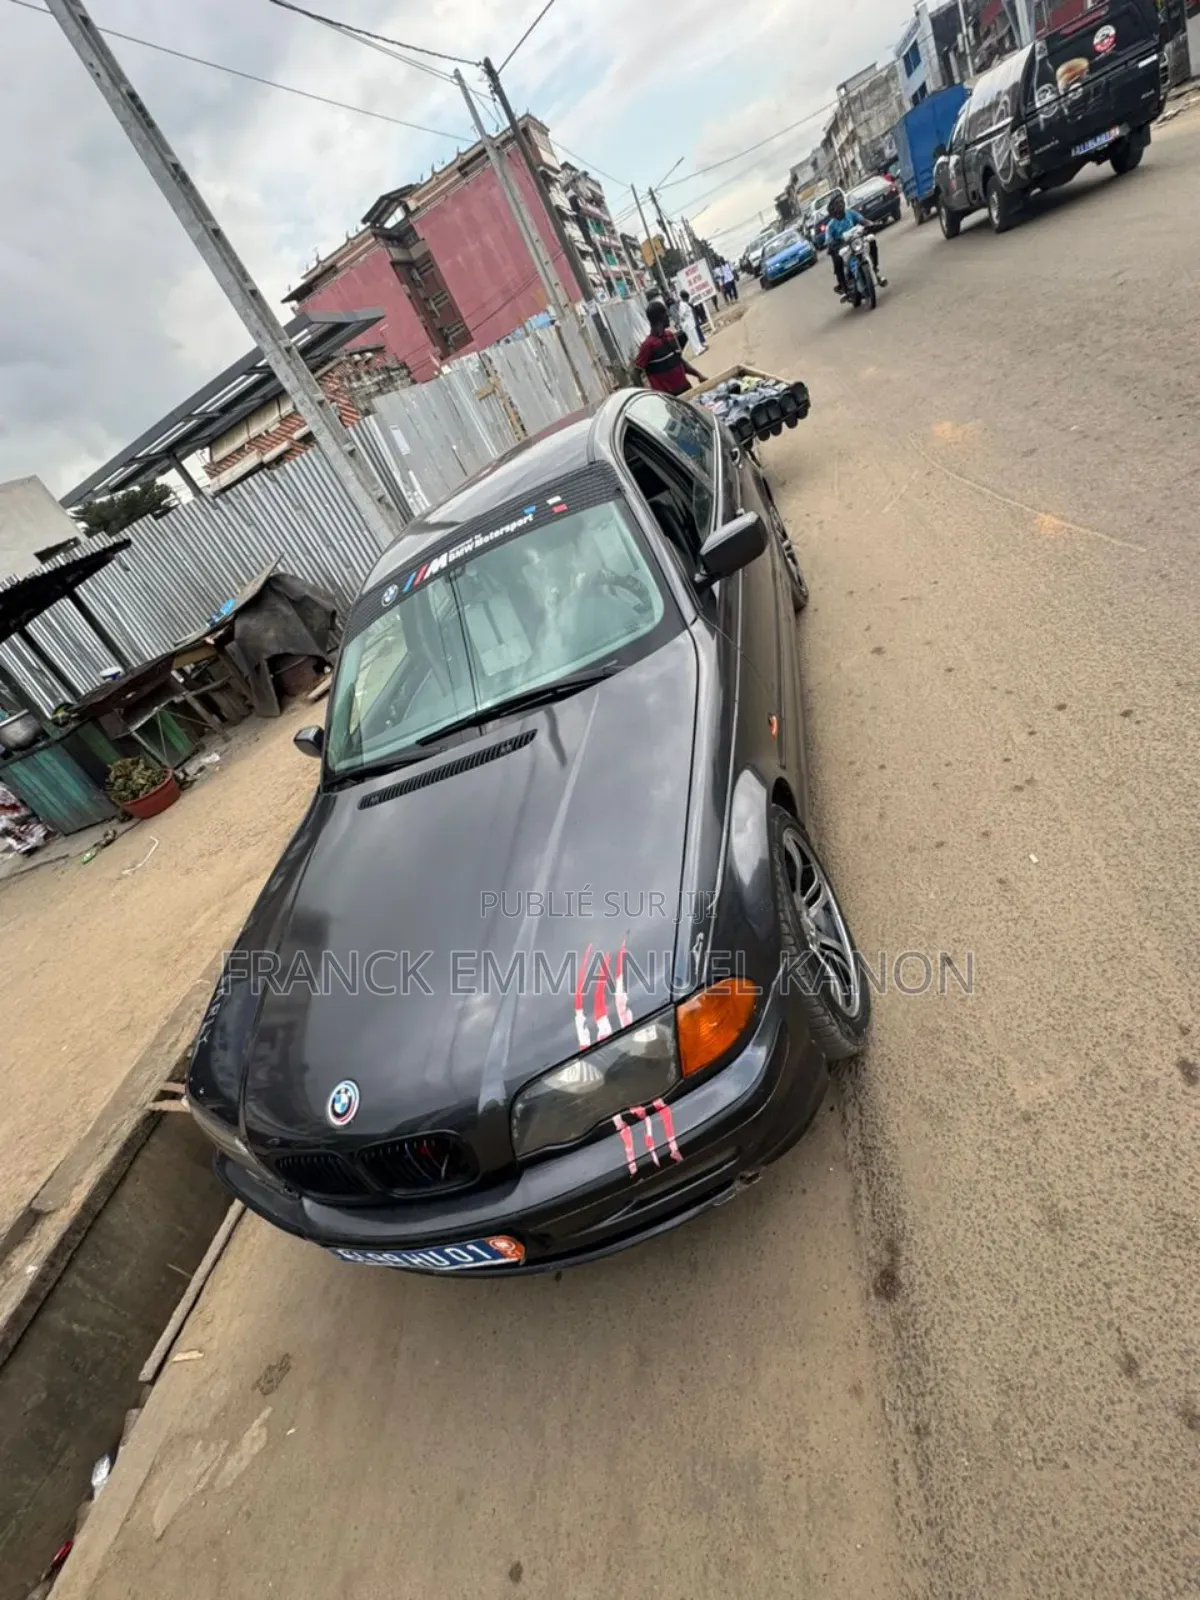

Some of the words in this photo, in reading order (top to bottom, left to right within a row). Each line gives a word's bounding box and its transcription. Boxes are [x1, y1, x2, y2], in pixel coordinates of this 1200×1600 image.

[424, 552, 447, 580] M
[474, 513, 533, 548] Motorsport
[444, 1244, 491, 1264] 01
